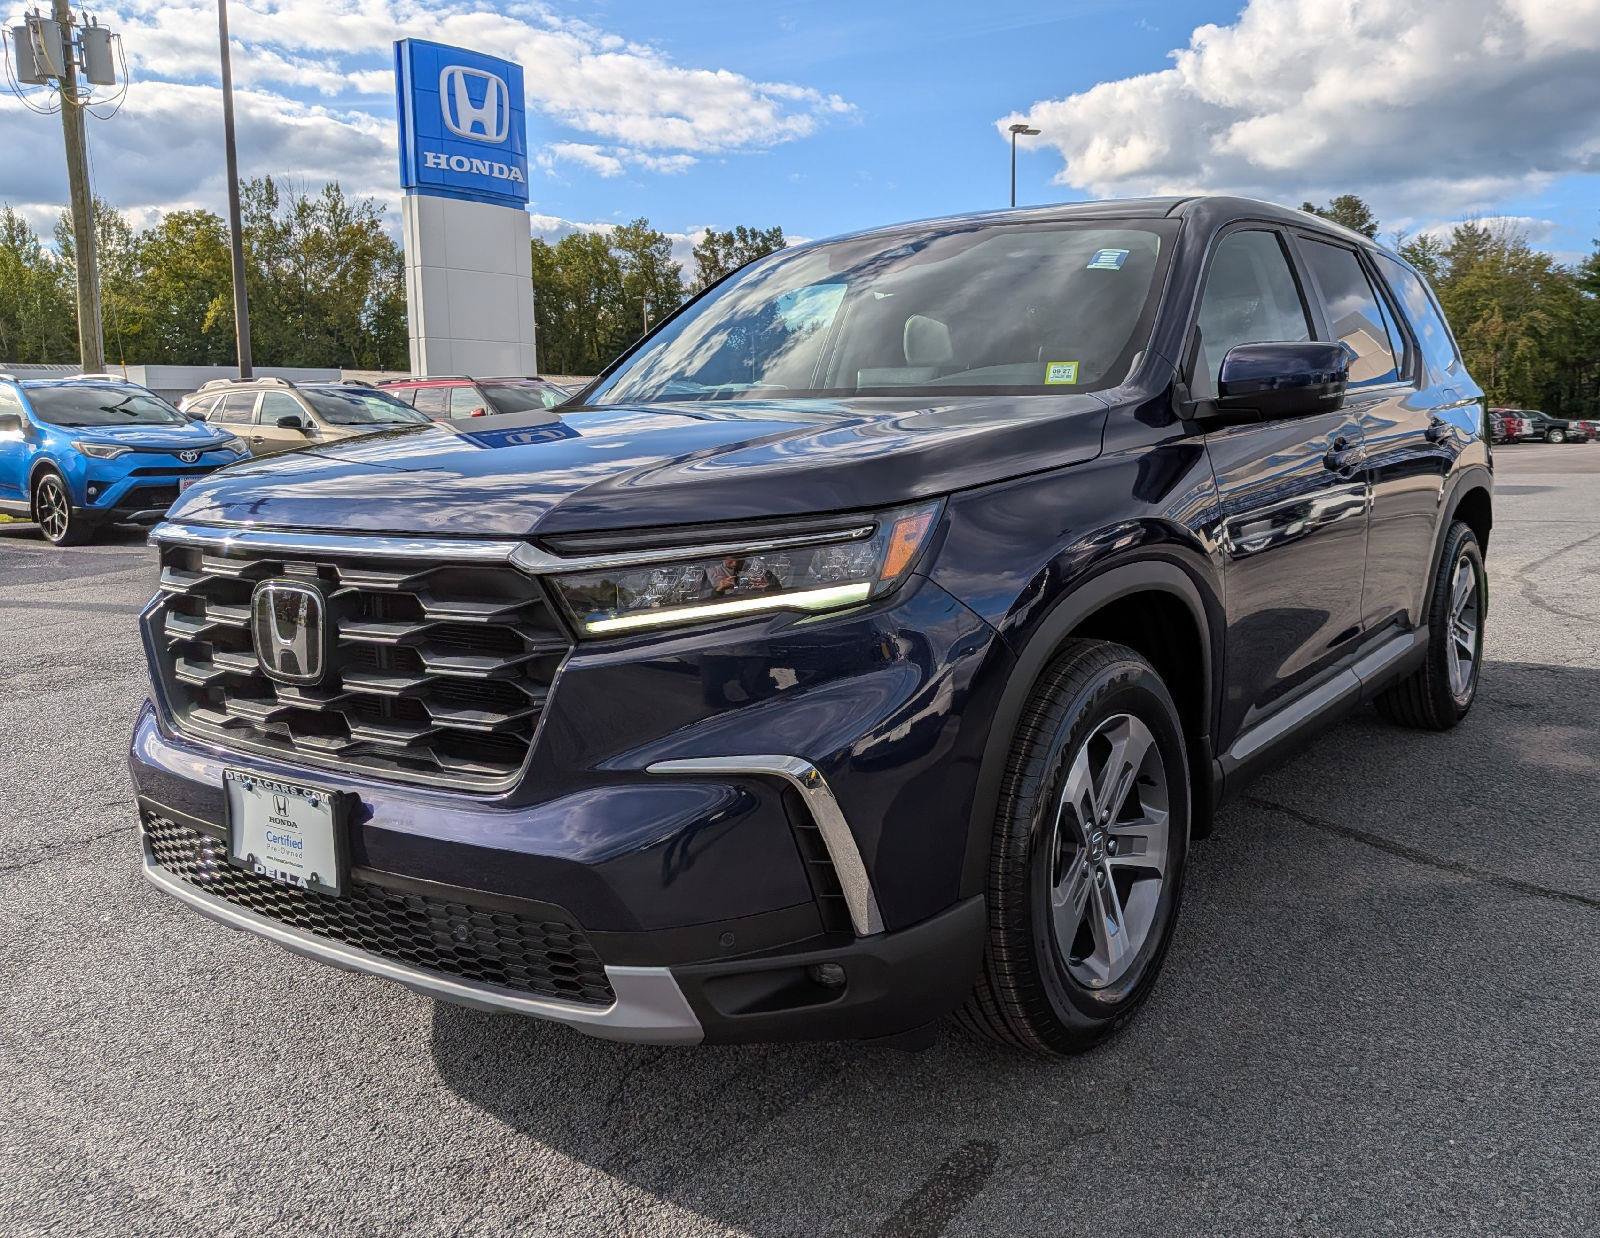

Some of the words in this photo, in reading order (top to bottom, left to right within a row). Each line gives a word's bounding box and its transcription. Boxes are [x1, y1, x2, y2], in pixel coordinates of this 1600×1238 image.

[424, 152, 525, 183] HONDA
[269, 816, 298, 829] HONDA
[266, 831, 303, 849] Certified
[266, 843, 303, 859] Pre-Owned
[255, 863, 309, 889] DELLA
